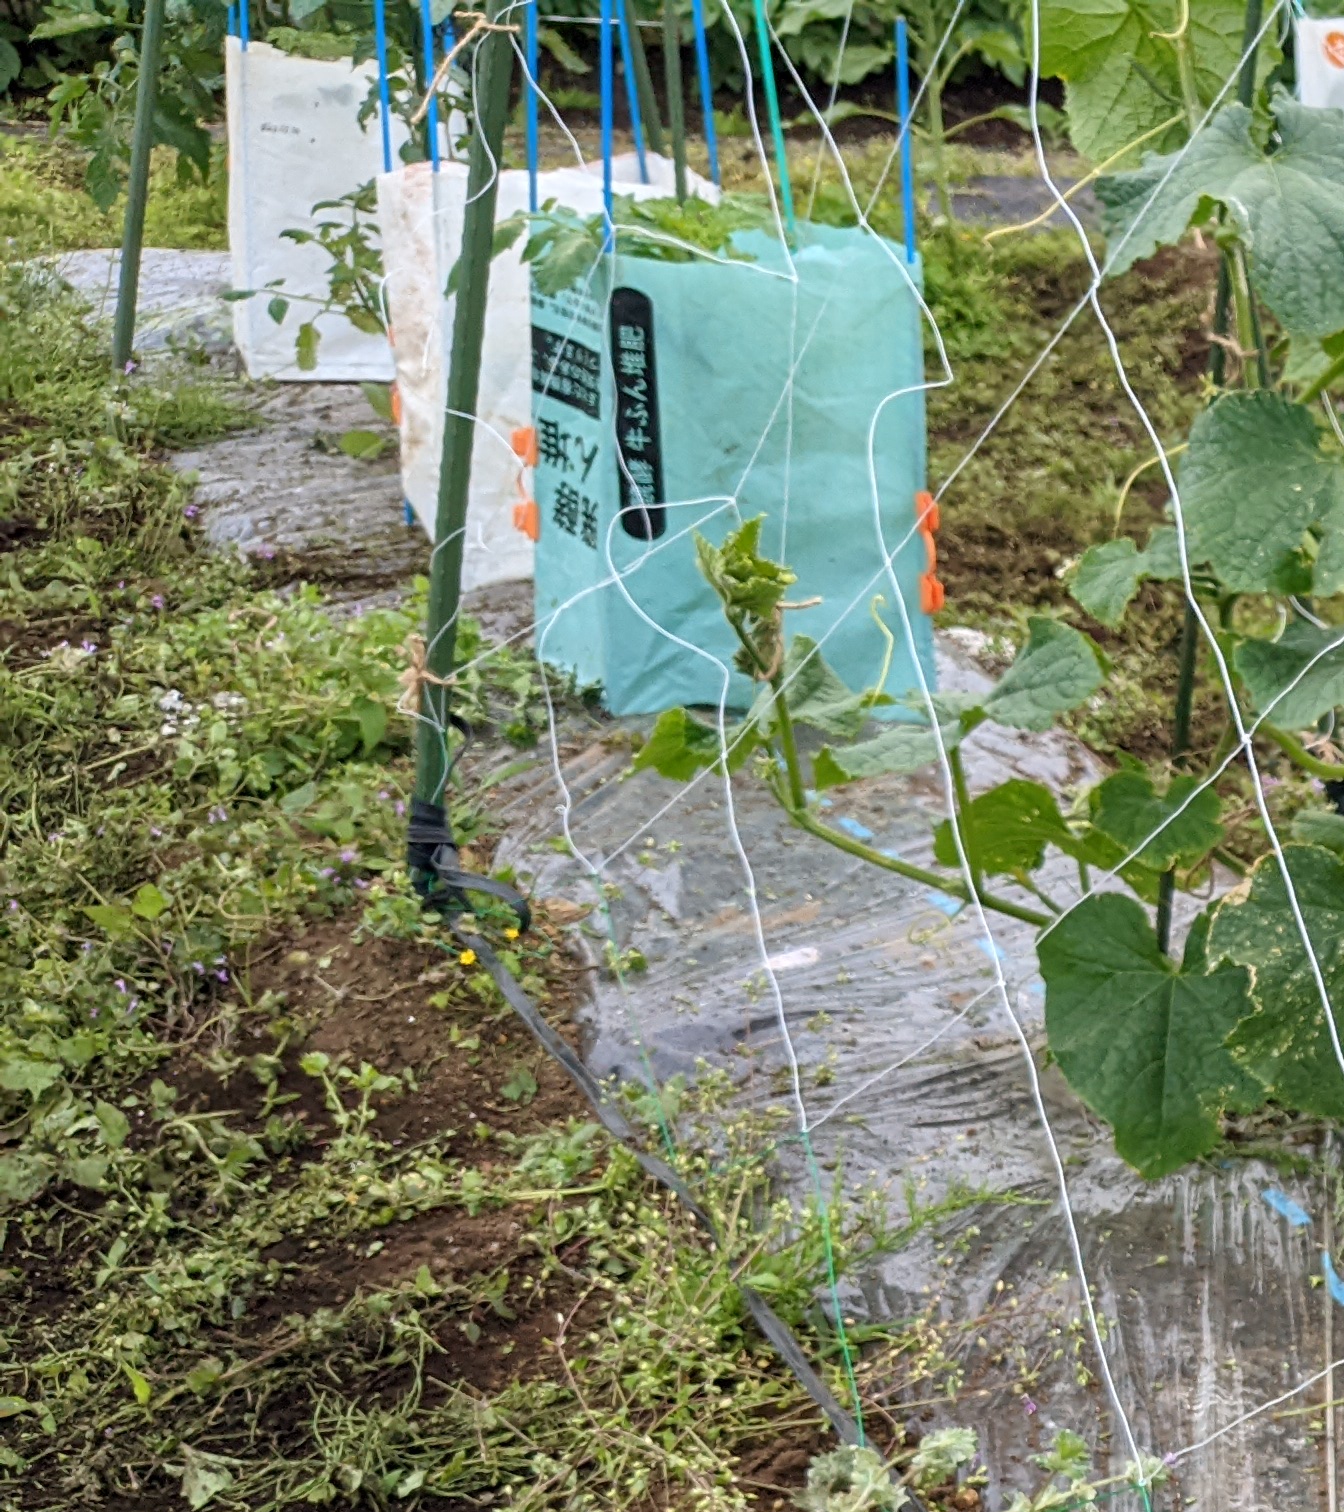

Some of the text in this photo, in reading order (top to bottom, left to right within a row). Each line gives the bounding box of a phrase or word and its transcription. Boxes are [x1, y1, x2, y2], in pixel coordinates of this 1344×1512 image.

[619, 324, 652, 452] 牛ふん堆肥
